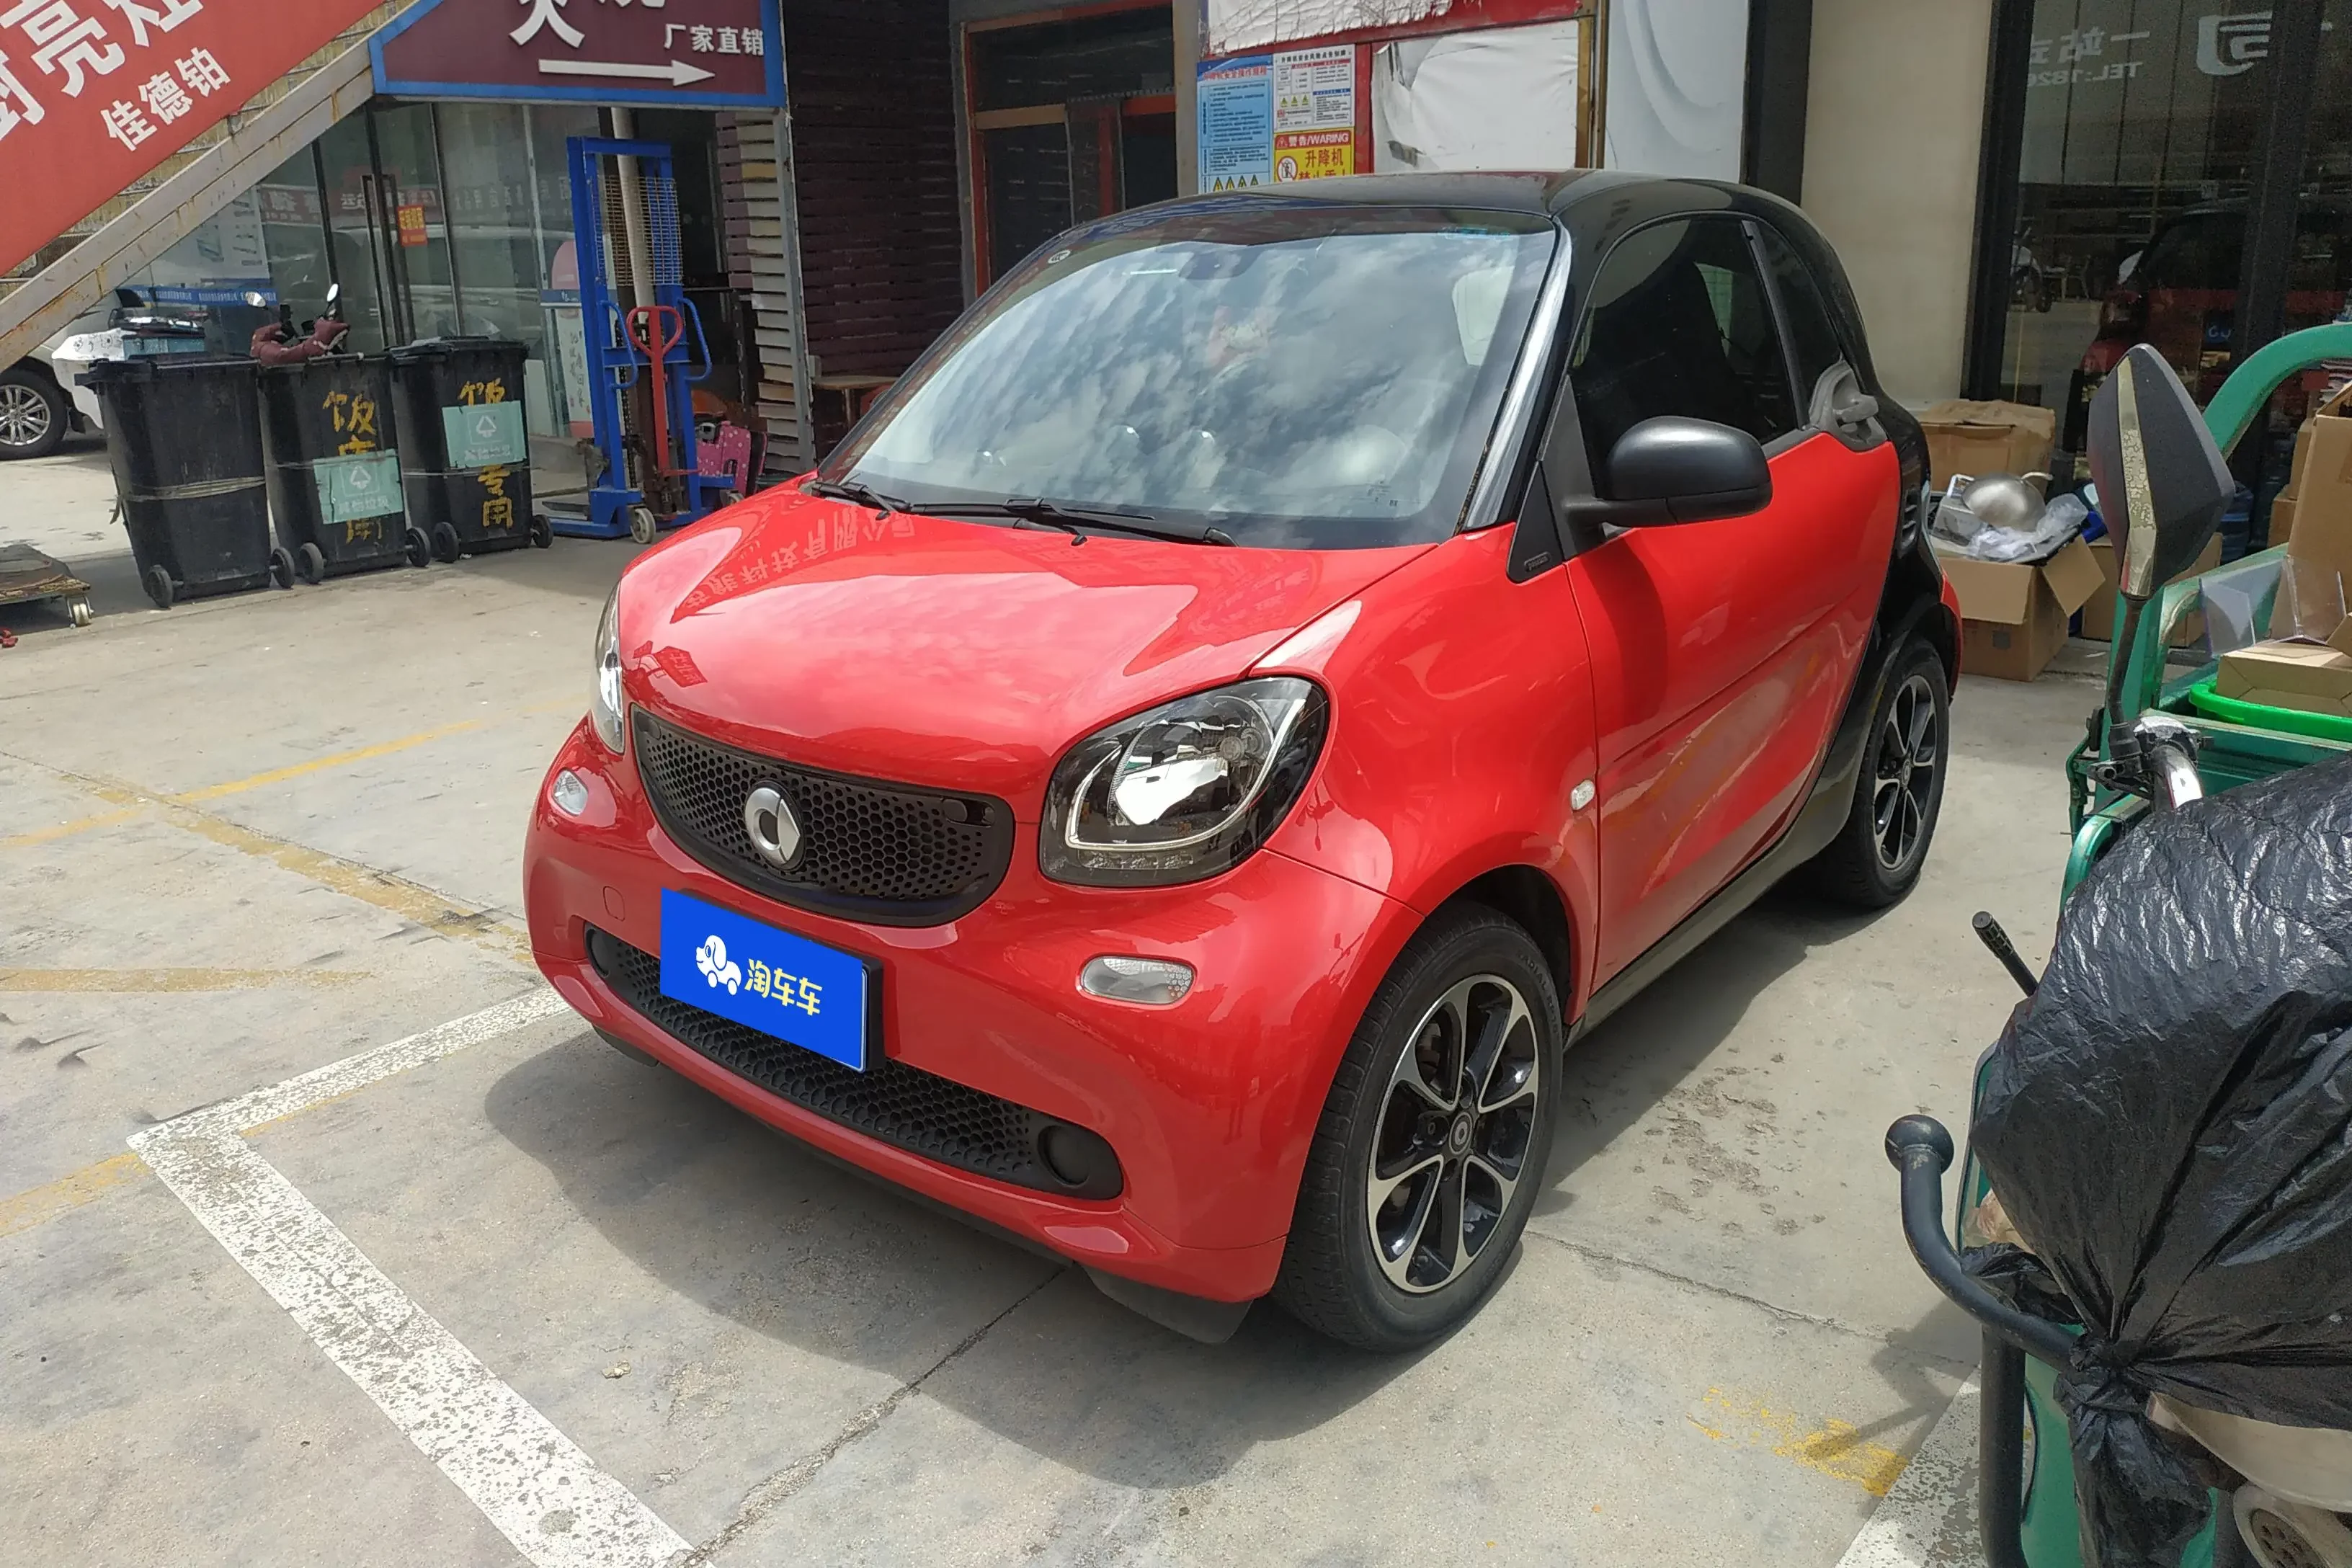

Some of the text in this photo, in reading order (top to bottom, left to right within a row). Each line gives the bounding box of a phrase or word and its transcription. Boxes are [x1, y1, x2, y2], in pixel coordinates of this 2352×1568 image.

[664, 22, 765, 56] 厂家直销
[99, 46, 231, 151] 佳德铂
[1305, 148, 1344, 168] 升降机
